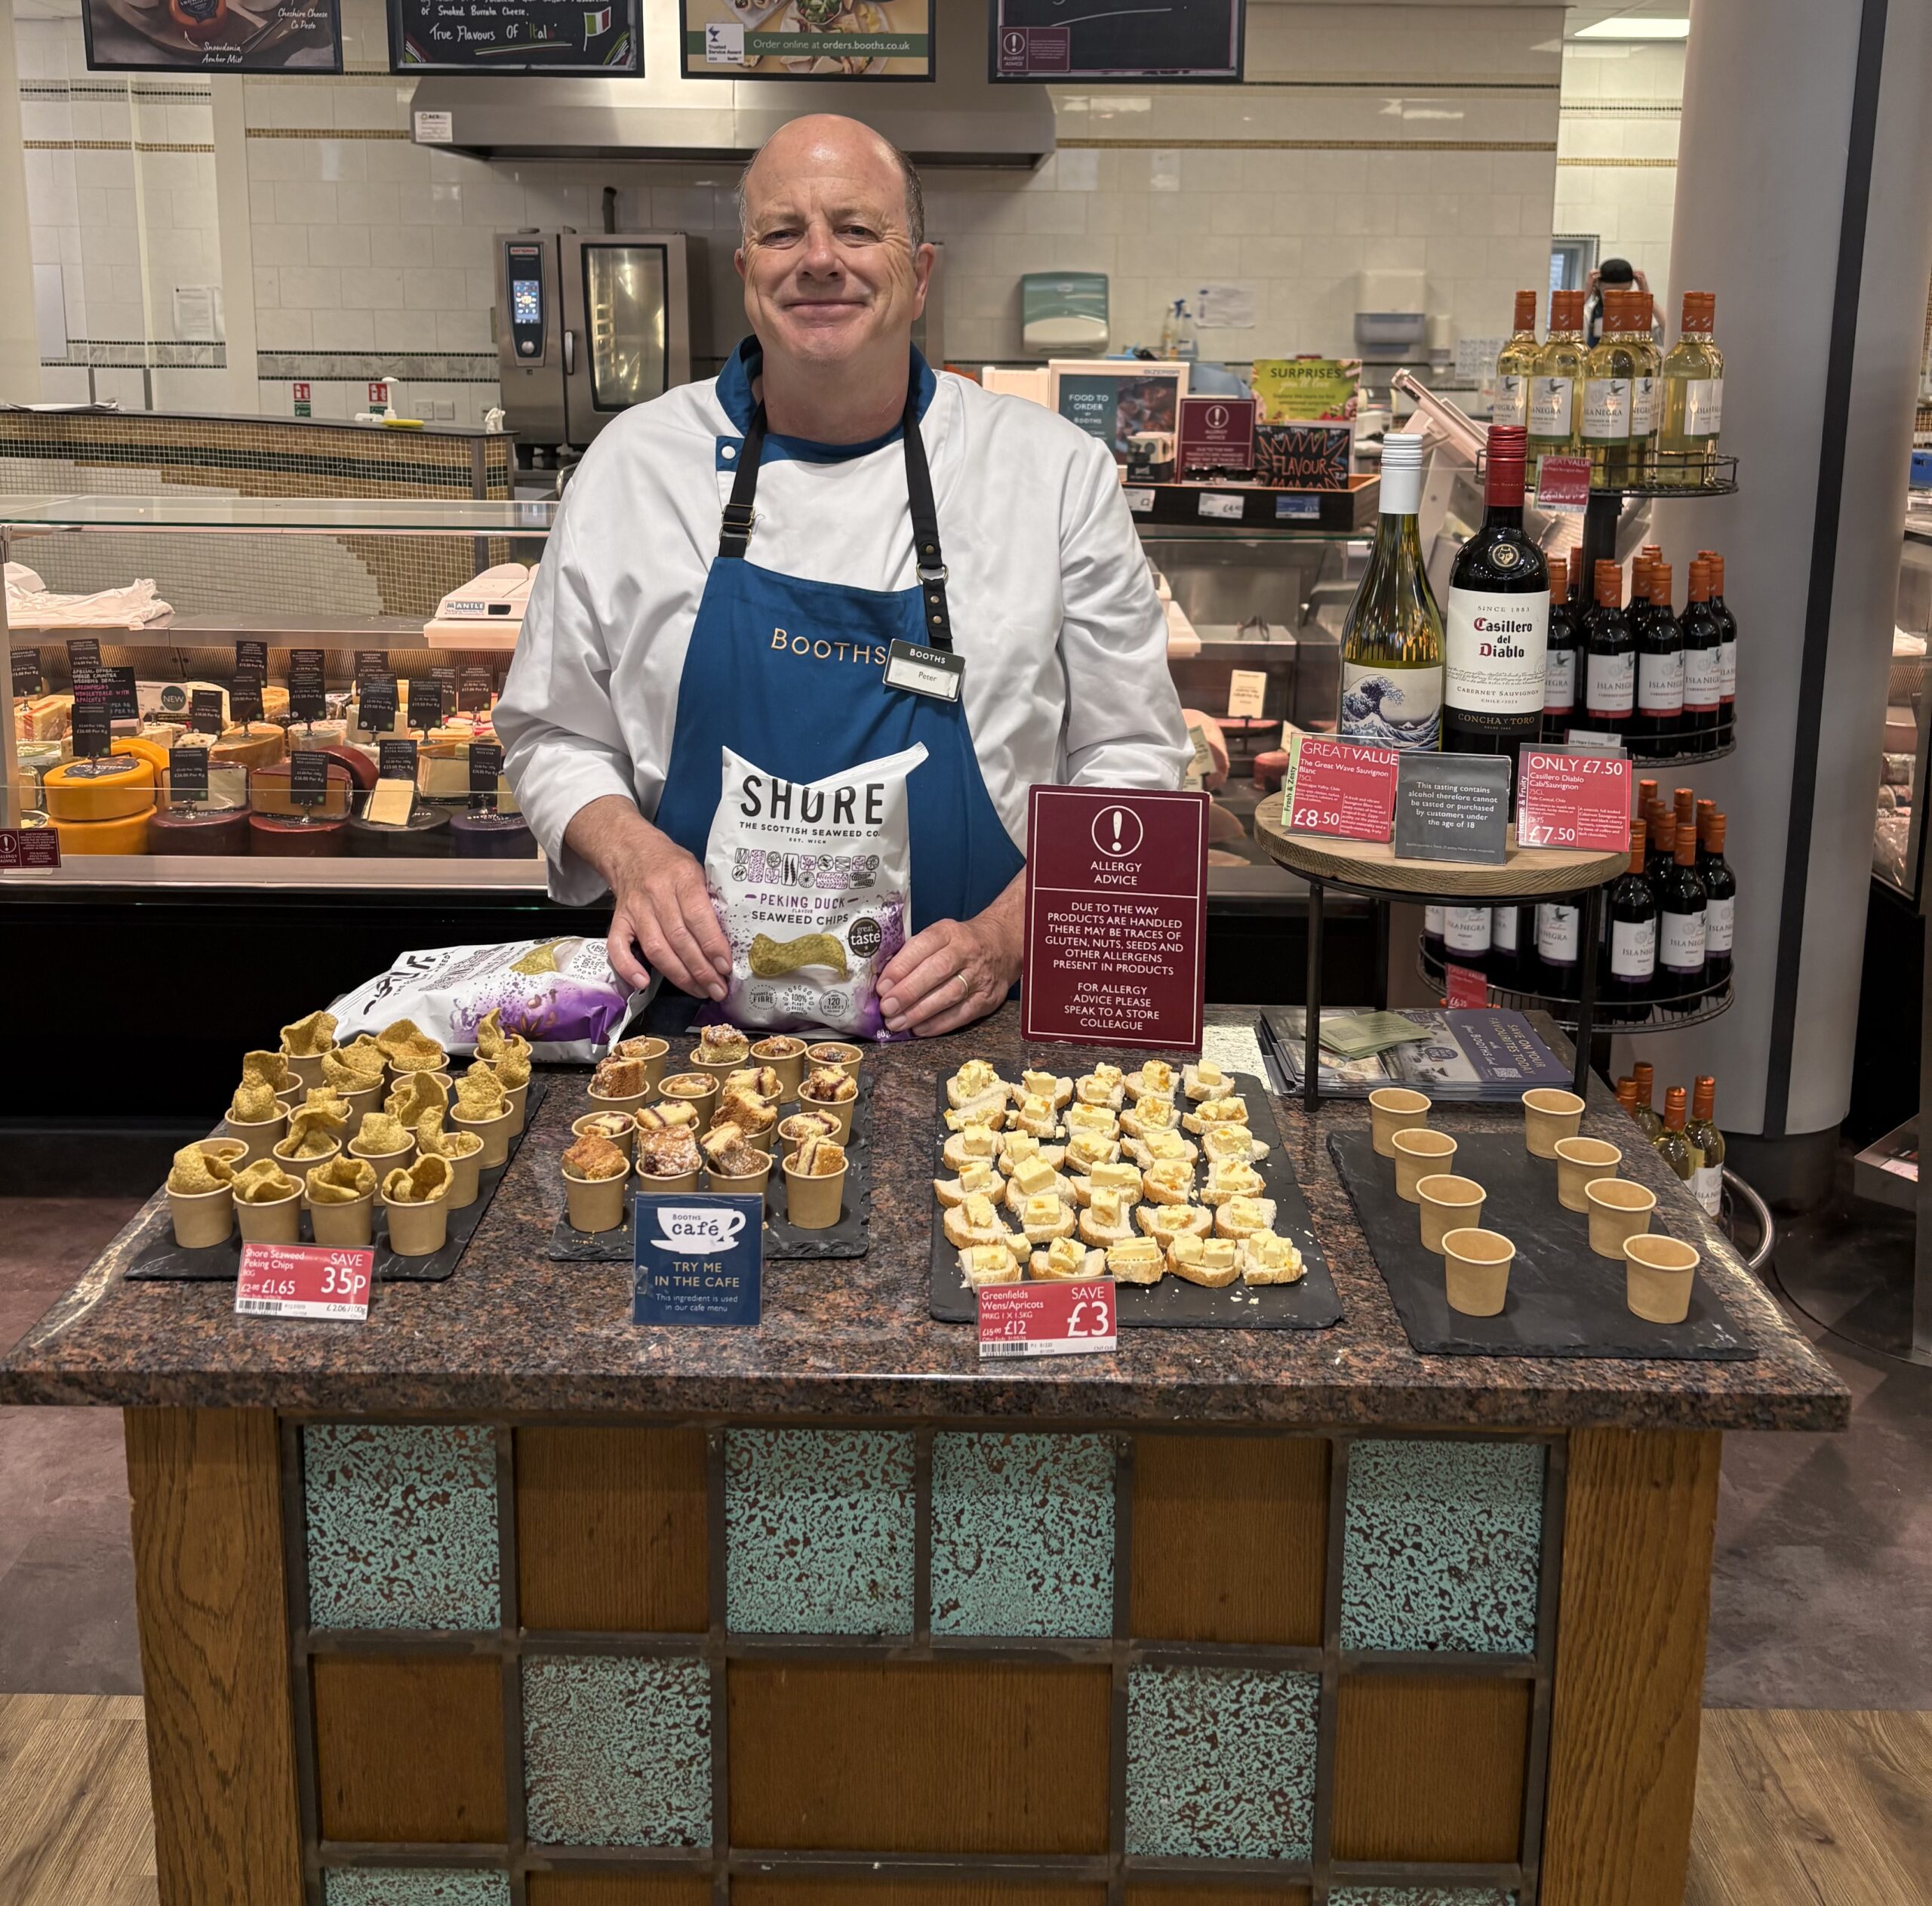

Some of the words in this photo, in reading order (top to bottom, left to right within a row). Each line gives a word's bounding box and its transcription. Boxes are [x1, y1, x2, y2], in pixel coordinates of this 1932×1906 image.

[307, 7, 328, 17] Cheese
[438, 5, 465, 16] Smoked
[471, 5, 497, 16] Burrata
[429, 23, 453, 41] True
[457, 25, 495, 42] Flavours
[506, 23, 518, 38] Of
[204, 42, 242, 52] Snowdonia
[753, 39, 781, 49] Order
[783, 40, 809, 49] online
[823, 41, 910, 51] orders.booths.co.uk
[202, 55, 226, 63] Amber
[1270, 368, 1342, 378] SURPRISES
[1272, 455, 1327, 476] FLAVOUR
[446, 602, 485, 610] MANTLE
[1474, 617, 1532, 633] Casillero
[771, 628, 887, 664] BOOTHS
[1497, 635, 1511, 644] del
[909, 648, 946, 664] BOOTHS
[1479, 643, 1524, 657] Diablo
[918, 671, 937, 682] Peter
[1457, 686, 1496, 695] CABERNET
[1459, 713, 1501, 724] CONCHA
[1510, 716, 1534, 725] TORO
[1299, 766, 1316, 774] Blanc
[1315, 761, 1334, 769] Great
[1336, 764, 1354, 772] Wave
[1356, 767, 1389, 777] Sauvignon
[1531, 756, 1580, 771] ONLY
[1583, 760, 1623, 775] £7.50
[1288, 765, 1297, 785] Zesty
[1530, 772, 1560, 781] Casillero
[1417, 781, 1432, 790] This
[1435, 784, 1458, 793] tasting
[1519, 776, 1527, 797] Fruity
[1284, 793, 1293, 812] Fresh
[1294, 808, 1340, 827] £8.50
[1417, 808, 1424, 817] by
[1426, 810, 1464, 818] customers
[740, 821, 758, 830] THE
[761, 824, 808, 835] SCOTTISH
[812, 829, 862, 837] SEAWEED
[1528, 826, 1575, 843] £7.50
[1091, 861, 1142, 872] ALLERGY
[1094, 874, 1138, 885] ADVICE
[760, 893, 809, 908] PEKING
[814, 897, 845, 909] DUCK
[1072, 902, 1093, 912] DUE
[1096, 904, 1109, 913] TO
[1112, 904, 1133, 913] THE
[1136, 906, 1158, 915] WAY
[752, 911, 812, 925] SEAWEED
[817, 913, 848, 925] CHIPS
[1048, 913, 1104, 924] PRODUCTS
[1107, 916, 1127, 925] ARE
[1131, 918, 1183, 928] HANDLED
[857, 925, 873, 935] great
[1048, 925, 1081, 935] THERE
[1084, 927, 1106, 935] MAY
[1109, 928, 1121, 937] BE
[1124, 928, 1163, 939] TRACES
[1167, 931, 1181, 941] OF
[851, 932, 881, 945] taste
[1045, 936, 1090, 947] GLUTEN,
[1093, 939, 1123, 949] NUTS,
[1126, 941, 1156, 950] SEEDS
[1159, 943, 1183, 952] AND
[1066, 949, 1100, 959] OTHER
[1103, 951, 1162, 962] ALLERGENS
[1054, 960, 1097, 971] PRESENT
[1101, 963, 1112, 971] IN
[1116, 964, 1174, 975] PRODUCTS
[1078, 983, 1098, 992] FOR
[1101, 984, 1147, 995] ALLERGY
[791, 993, 807, 1002] 100%
[828, 997, 841, 1005] 120
[1073, 995, 1112, 1005] ADVICE
[1115, 996, 1151, 1007] PLEASE
[1065, 1005, 1095, 1015] SPEAK
[1098, 1008, 1113, 1016] TO
[1126, 1009, 1159, 1019] STORE
[1080, 1018, 1143, 1030] COLLEAGUE
[1470, 1034, 1493, 1057] BOOTHS
[1488, 1017, 1520, 1052] FAVOURITES
[1513, 1053, 1537, 1075] TODAY
[1508, 1024, 1525, 1039] SAVE
[1518, 1039, 1534, 1050] ON
[1527, 1050, 1546, 1067] YOUR
[672, 1219, 719, 1236] café
[245, 1248, 269, 1258] Shore
[271, 1250, 305, 1260] Seaweed
[331, 1253, 363, 1267] SAVE
[244, 1258, 269, 1270] Peking
[272, 1260, 294, 1271] Chips
[673, 1261, 699, 1272] TRY
[703, 1262, 722, 1273] ME
[261, 1279, 296, 1295] £1.65
[654, 1276, 669, 1286] IN
[673, 1276, 700, 1286] THE
[705, 1277, 740, 1287] CAFE
[656, 1293, 671, 1301] This
[674, 1294, 710, 1303] ingredient
[982, 1290, 1029, 1301] Greenfields
[1072, 1286, 1104, 1300] SAVE
[982, 1301, 1044, 1310] Wens/Apricots
[1067, 1301, 1109, 1337] £3
[1004, 1320, 1026, 1335] £12
